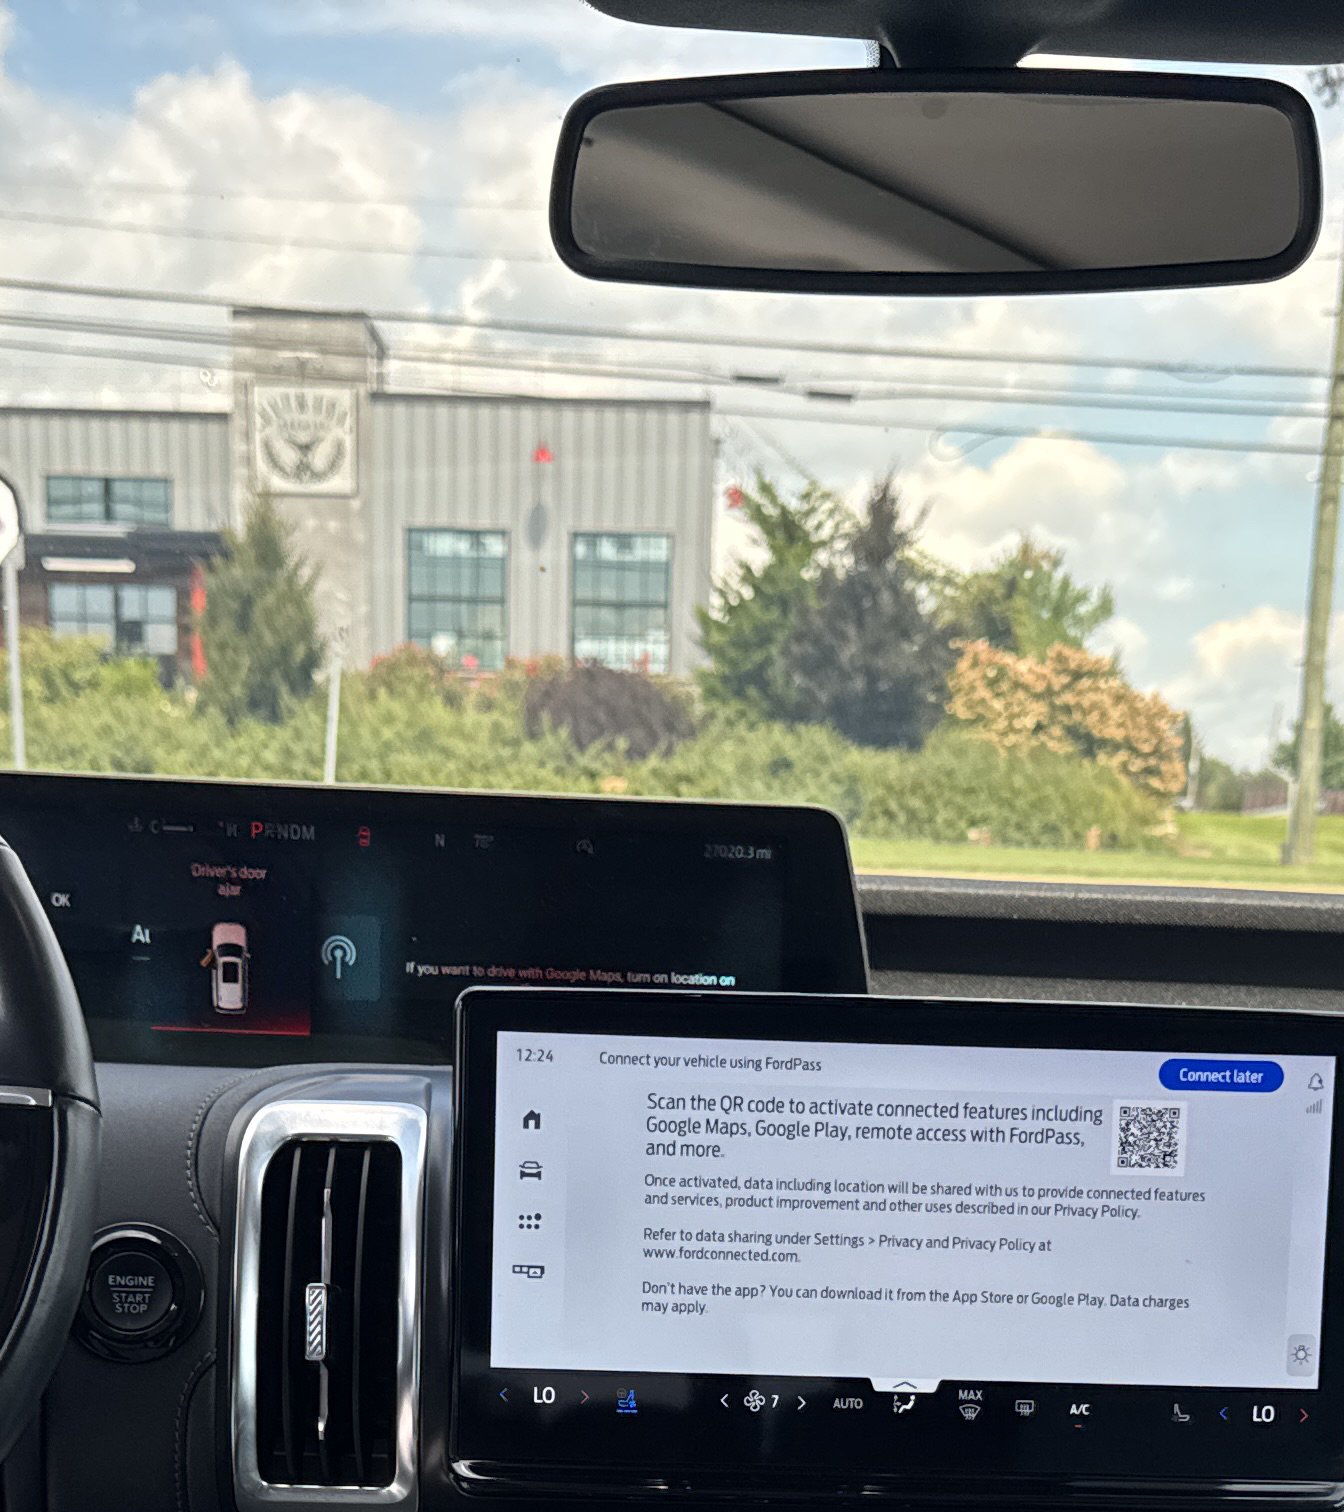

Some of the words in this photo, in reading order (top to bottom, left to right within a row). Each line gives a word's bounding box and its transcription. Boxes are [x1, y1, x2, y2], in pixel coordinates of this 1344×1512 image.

[238, 865, 268, 880] door
[405, 961, 415, 973] If
[417, 964, 439, 977] you
[441, 964, 470, 976] want
[473, 965, 485, 977] to
[487, 966, 516, 978] drive
[518, 967, 544, 979] with
[545, 968, 587, 982] Google
[590, 969, 625, 983] Maps,
[627, 971, 650, 984] turn
[652, 973, 669, 984] on
[671, 972, 718, 986] location
[719, 975, 736, 986] on
[515, 1047, 554, 1063] 12:24
[599, 1050, 652, 1066] Connect
[653, 1055, 682, 1069] your
[682, 1053, 728, 1069] vehicle
[729, 1056, 763, 1072] using
[765, 1055, 822, 1072] FordPass
[1178, 1067, 1232, 1083] Connect
[1232, 1068, 1264, 1084] later
[646, 1092, 686, 1111] Scan
[689, 1093, 716, 1112] the
[719, 1094, 744, 1115] QR
[746, 1095, 785, 1114] code
[788, 1097, 805, 1115] to
[808, 1098, 873, 1117] activate
[876, 1101, 959, 1119] connected
[962, 1101, 1028, 1121] features
[1030, 1104, 1103, 1126] including
[645, 1115, 701, 1137] Google
[704, 1117, 751, 1138] Maps,
[754, 1118, 810, 1141] Google
[813, 1121, 852, 1142] Play,
[854, 1123, 913, 1141] remote
[915, 1127, 966, 1143] access
[969, 1126, 1006, 1143] with
[1008, 1126, 1085, 1148] FordPass,
[644, 1139, 676, 1157] and
[679, 1143, 724, 1158] more.
[644, 1173, 677, 1188] Once
[678, 1175, 742, 1191] activated,
[743, 1176, 774, 1190] data
[775, 1177, 832, 1195] including
[833, 1178, 885, 1194] location
[887, 1180, 909, 1195] will
[911, 1181, 928, 1195] be
[930, 1181, 973, 1196] shared
[974, 1183, 1003, 1197] with
[1004, 1186, 1019, 1198] us
[1021, 1184, 1036, 1198] to
[1037, 1185, 1084, 1200] provide
[1086, 1187, 1152, 1201] connected
[1153, 1187, 1206, 1202] features
[644, 1191, 669, 1205] and
[670, 1193, 723, 1208] services,
[724, 1194, 774, 1210] product
[775, 1196, 860, 1211] improvement
[862, 1197, 887, 1212] and
[888, 1198, 923, 1213] other
[924, 1202, 953, 1214] uses
[954, 1200, 1015, 1215] described
[1017, 1204, 1029, 1216] in
[1030, 1205, 1052, 1216] our
[1053, 1202, 1099, 1220] Privacy
[1100, 1203, 1141, 1221] Policy.
[643, 1226, 677, 1241] Refer
[679, 1228, 693, 1242] to
[695, 1228, 725, 1243] data
[727, 1229, 773, 1247] sharing
[774, 1231, 812, 1245] under
[813, 1232, 865, 1249] Settings
[868, 1236, 876, 1245] >
[878, 1234, 924, 1251] Privacy
[925, 1235, 950, 1249] and
[951, 1236, 997, 1253] Privacy
[998, 1236, 1037, 1254] Policy
[1038, 1239, 1052, 1252] at
[642, 1245, 801, 1263] www.fordconnected.com.
[108, 1275, 155, 1286] ENGINE
[112, 1293, 151, 1304] START
[641, 1280, 676, 1295] Don't
[678, 1281, 709, 1296] have
[711, 1282, 732, 1296] the
[734, 1284, 767, 1299] app?
[768, 1284, 794, 1298] You
[795, 1288, 818, 1299] can
[820, 1285, 883, 1301] download
[884, 1288, 894, 1301] it
[896, 1287, 927, 1302] from
[928, 1288, 950, 1303] the
[951, 1289, 978, 1305] App
[980, 1290, 1014, 1305] Store
[1016, 1293, 1030, 1305] or
[1030, 1291, 1075, 1308] Google
[1077, 1292, 1105, 1309] Play.
[1109, 1293, 1140, 1308] Data
[1142, 1294, 1190, 1311] charges
[115, 1303, 148, 1314] STOP
[641, 1301, 669, 1315] may
[670, 1299, 707, 1316] apply.
[533, 1385, 556, 1404] LO
[771, 1393, 779, 1408] 7
[832, 1397, 864, 1410] AUTO
[957, 1388, 983, 1401] MAX
[1069, 1403, 1090, 1416] A/C
[1252, 1404, 1275, 1423] LO
